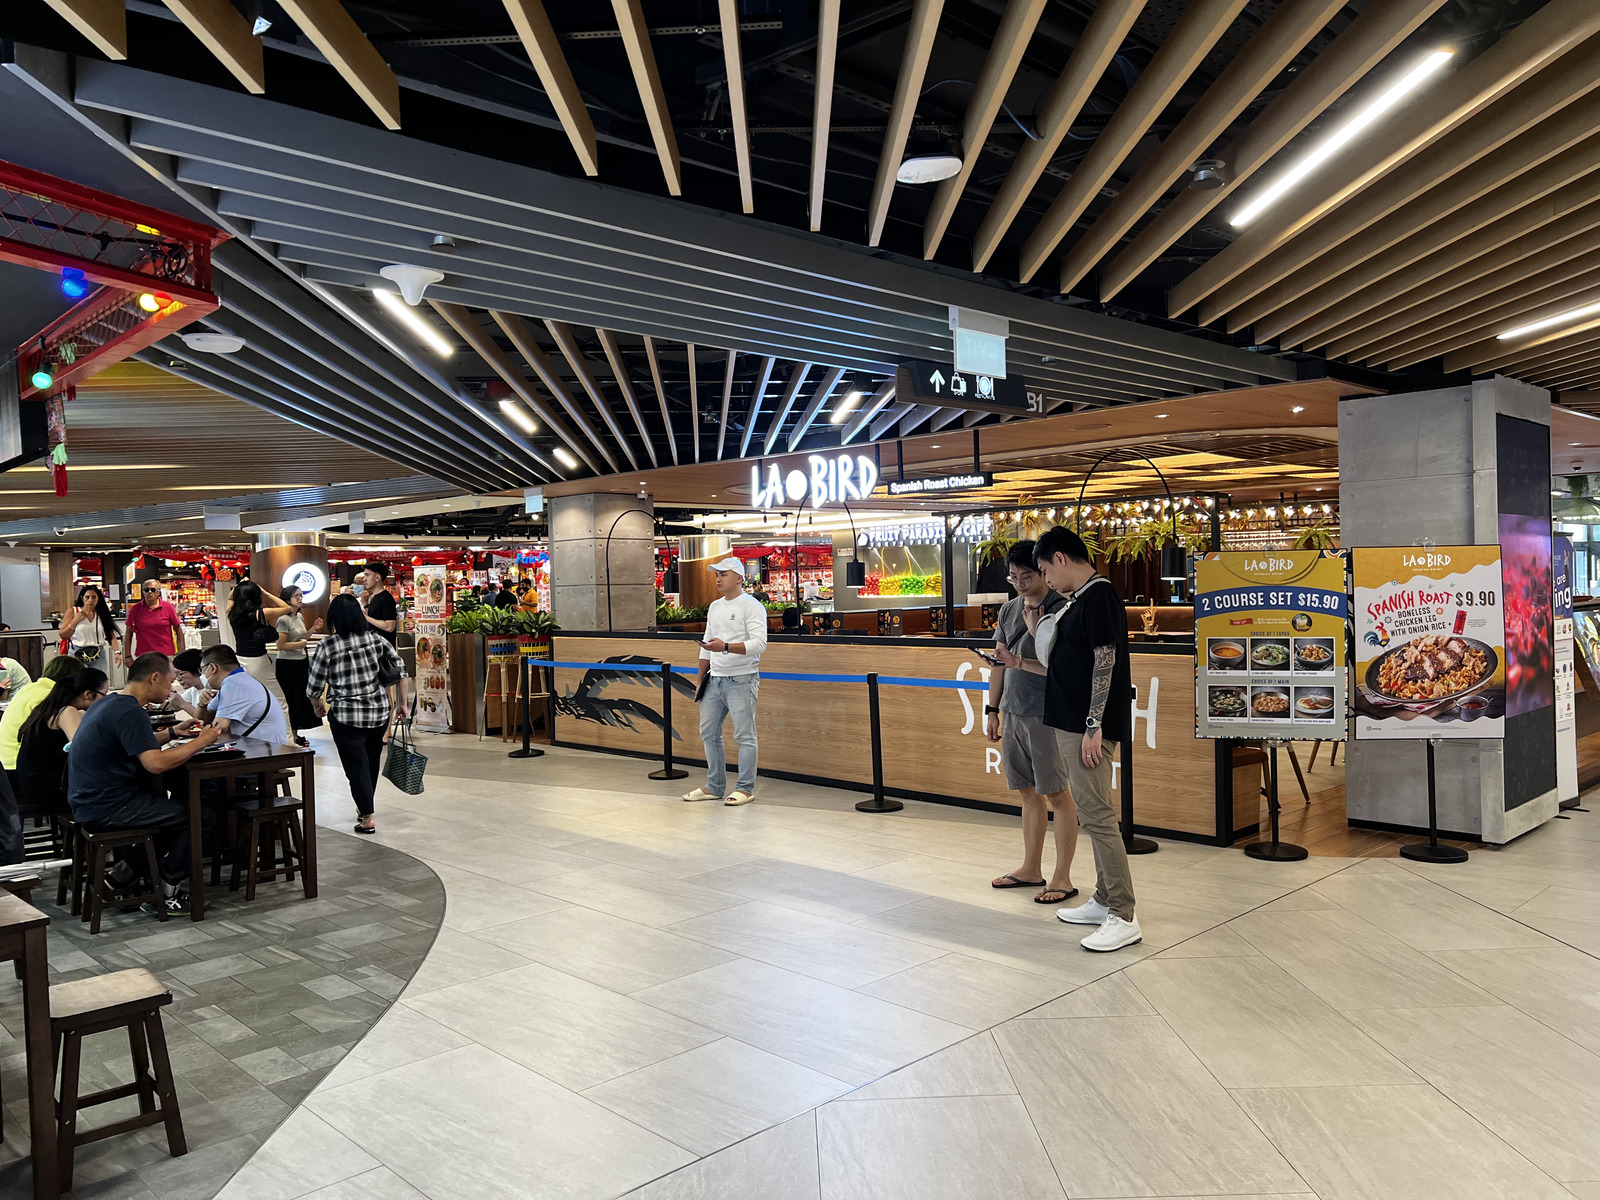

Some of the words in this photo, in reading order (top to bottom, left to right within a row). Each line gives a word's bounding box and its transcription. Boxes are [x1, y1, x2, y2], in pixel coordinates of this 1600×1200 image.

[1026, 391, 1043, 413] B1
[808, 454, 878, 509] BIRD
[890, 480, 923, 494] Spanish
[923, 477, 949, 490] Roast
[948, 475, 985, 488] Chicken
[869, 528, 900, 543] FRUIT
[902, 525, 946, 540] PARADIS
[963, 523, 992, 537] CAFE
[1244, 559, 1258, 572] LA
[1269, 558, 1294, 572] BIRD
[1403, 554, 1417, 568] LA
[1426, 553, 1452, 568] BIRD
[1556, 573, 1567, 586] are
[1202, 597, 1211, 611] 2
[1214, 592, 1265, 609] COURSE
[1269, 592, 1293, 606] SET
[1298, 592, 1339, 610] $15.90
[1367, 590, 1415, 621] SPANISH
[1418, 590, 1454, 606] ROAST
[1455, 590, 1496, 607] $9.90
[1554, 586, 1572, 610] ing
[421, 605, 440, 615] LUNCH
[1397, 606, 1431, 619] BONELESS
[1390, 628, 1407, 637] WITH
[1408, 625, 1430, 635] ONION
[1431, 621, 1446, 631] RICE
[1394, 616, 1424, 628] CHICKEN
[1424, 614, 1437, 623] LEG
[415, 624, 436, 635] $10.90
